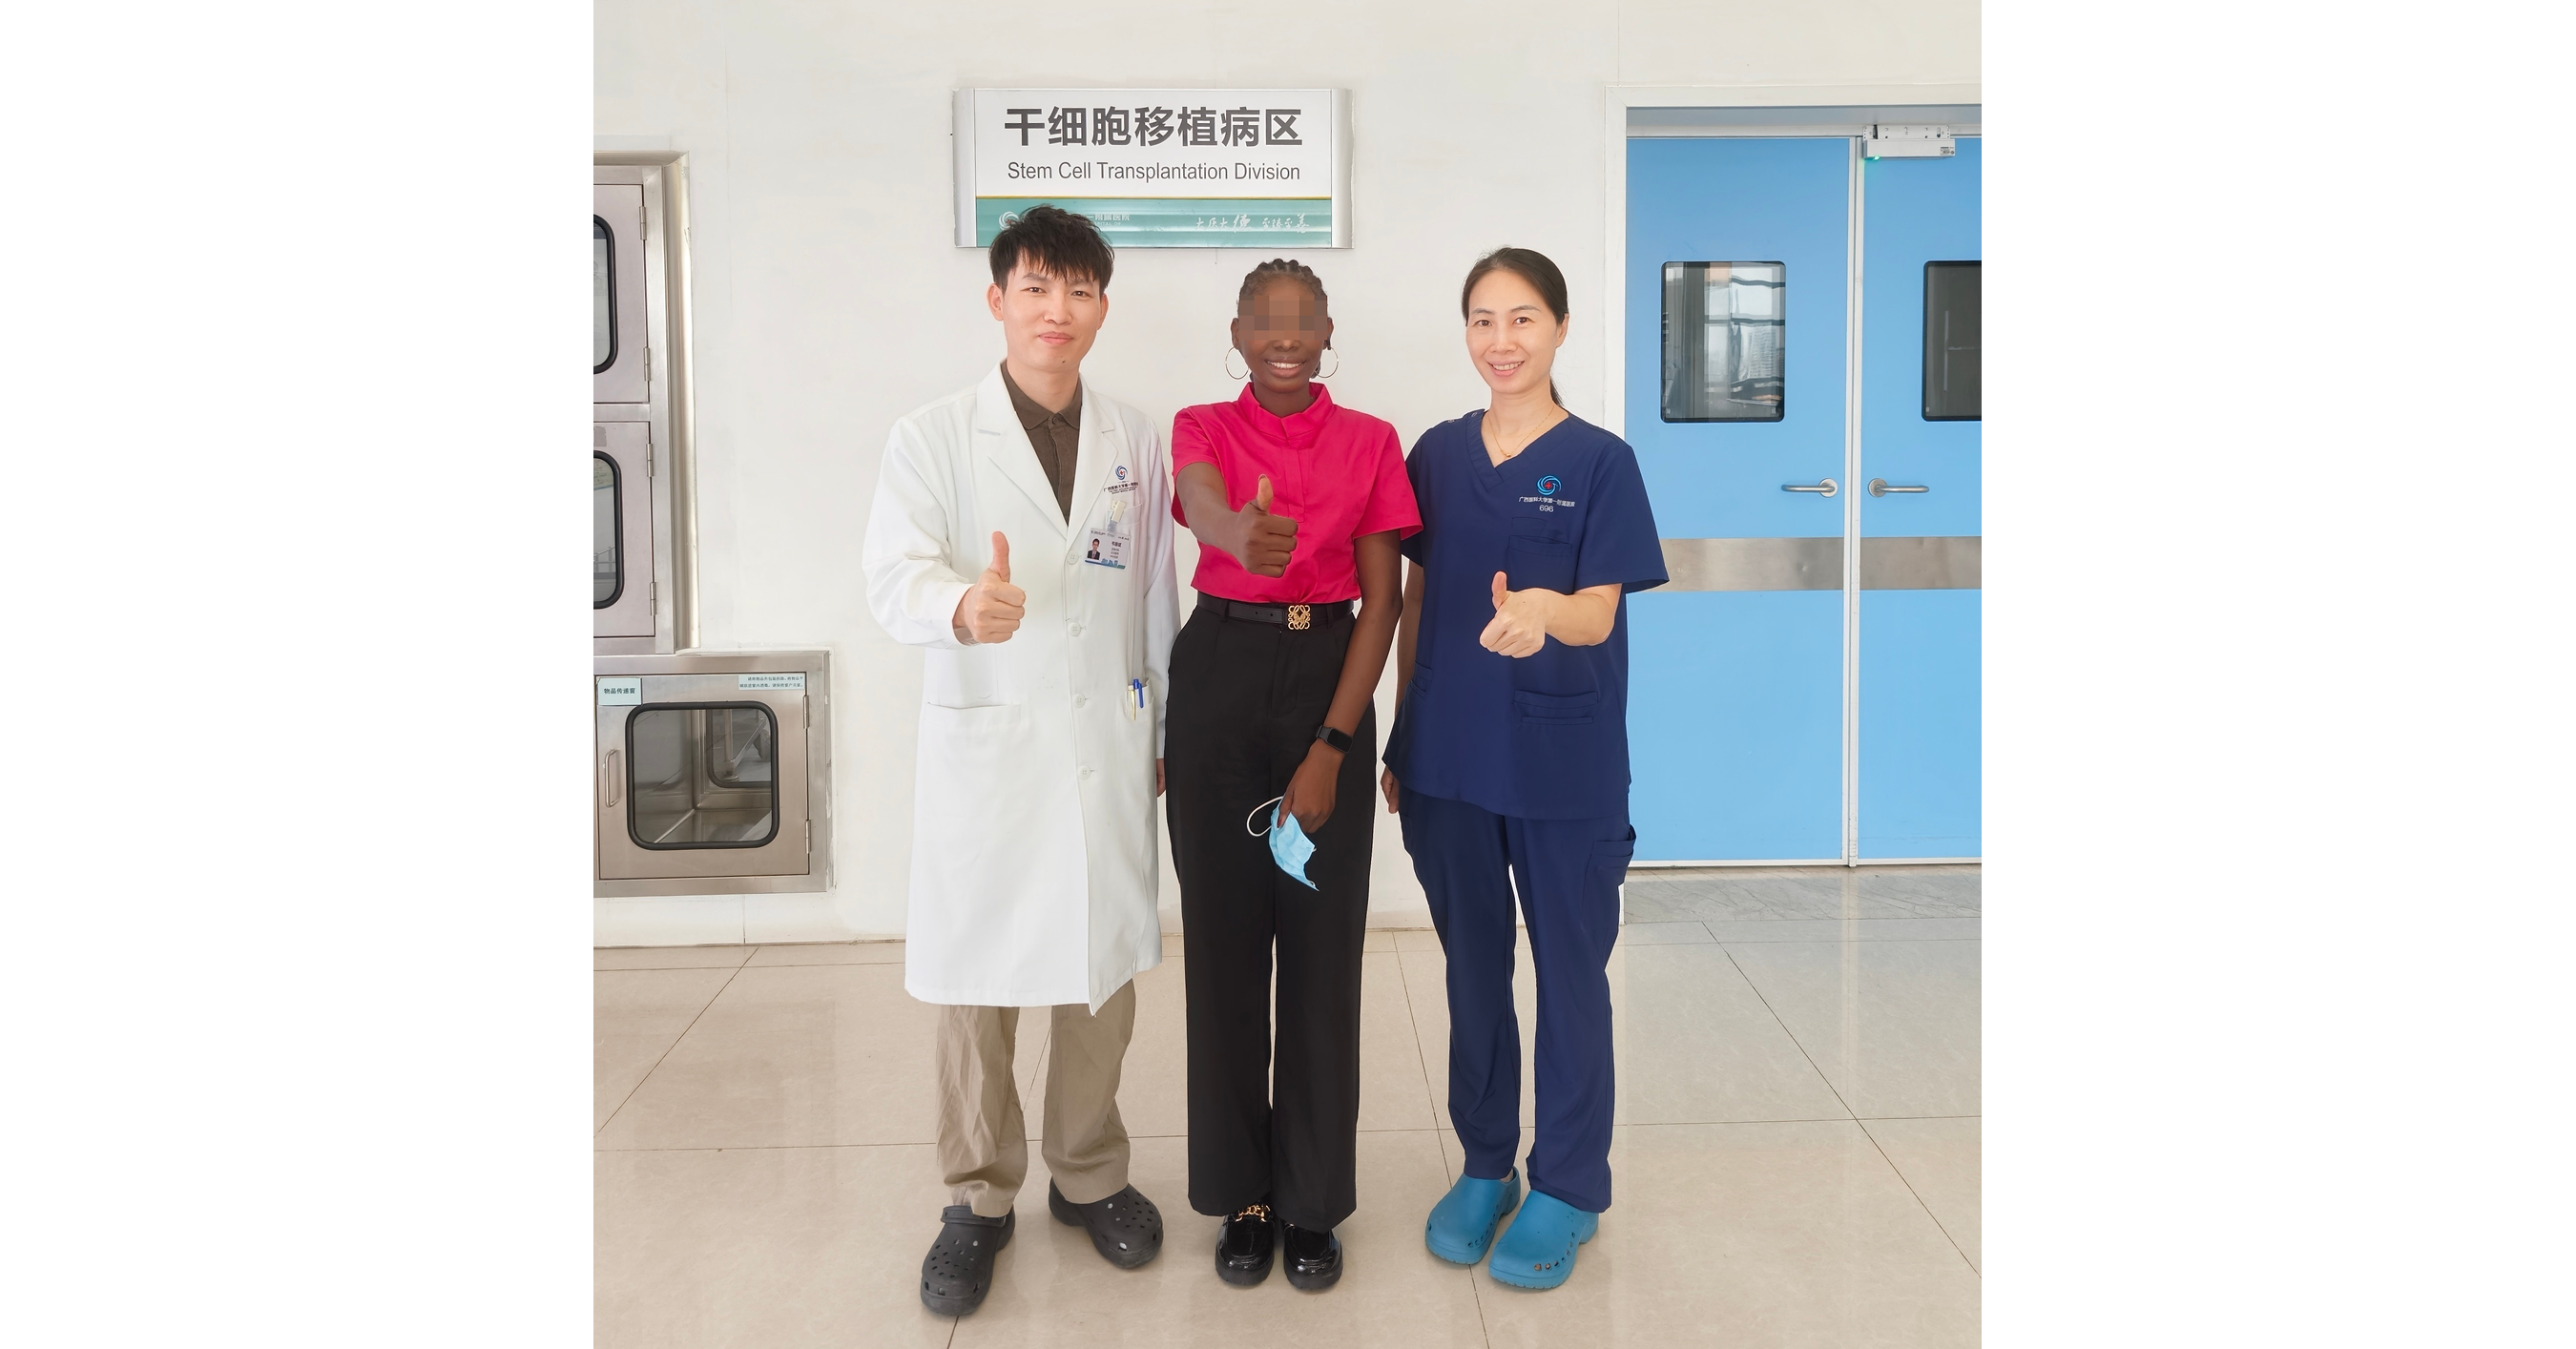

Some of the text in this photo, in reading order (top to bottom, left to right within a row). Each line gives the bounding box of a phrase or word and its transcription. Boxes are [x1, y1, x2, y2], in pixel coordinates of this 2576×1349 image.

[1004, 106, 1303, 147] 干细胞移植病区
[1008, 162, 1300, 183] Stem Cell Transplantation Division
